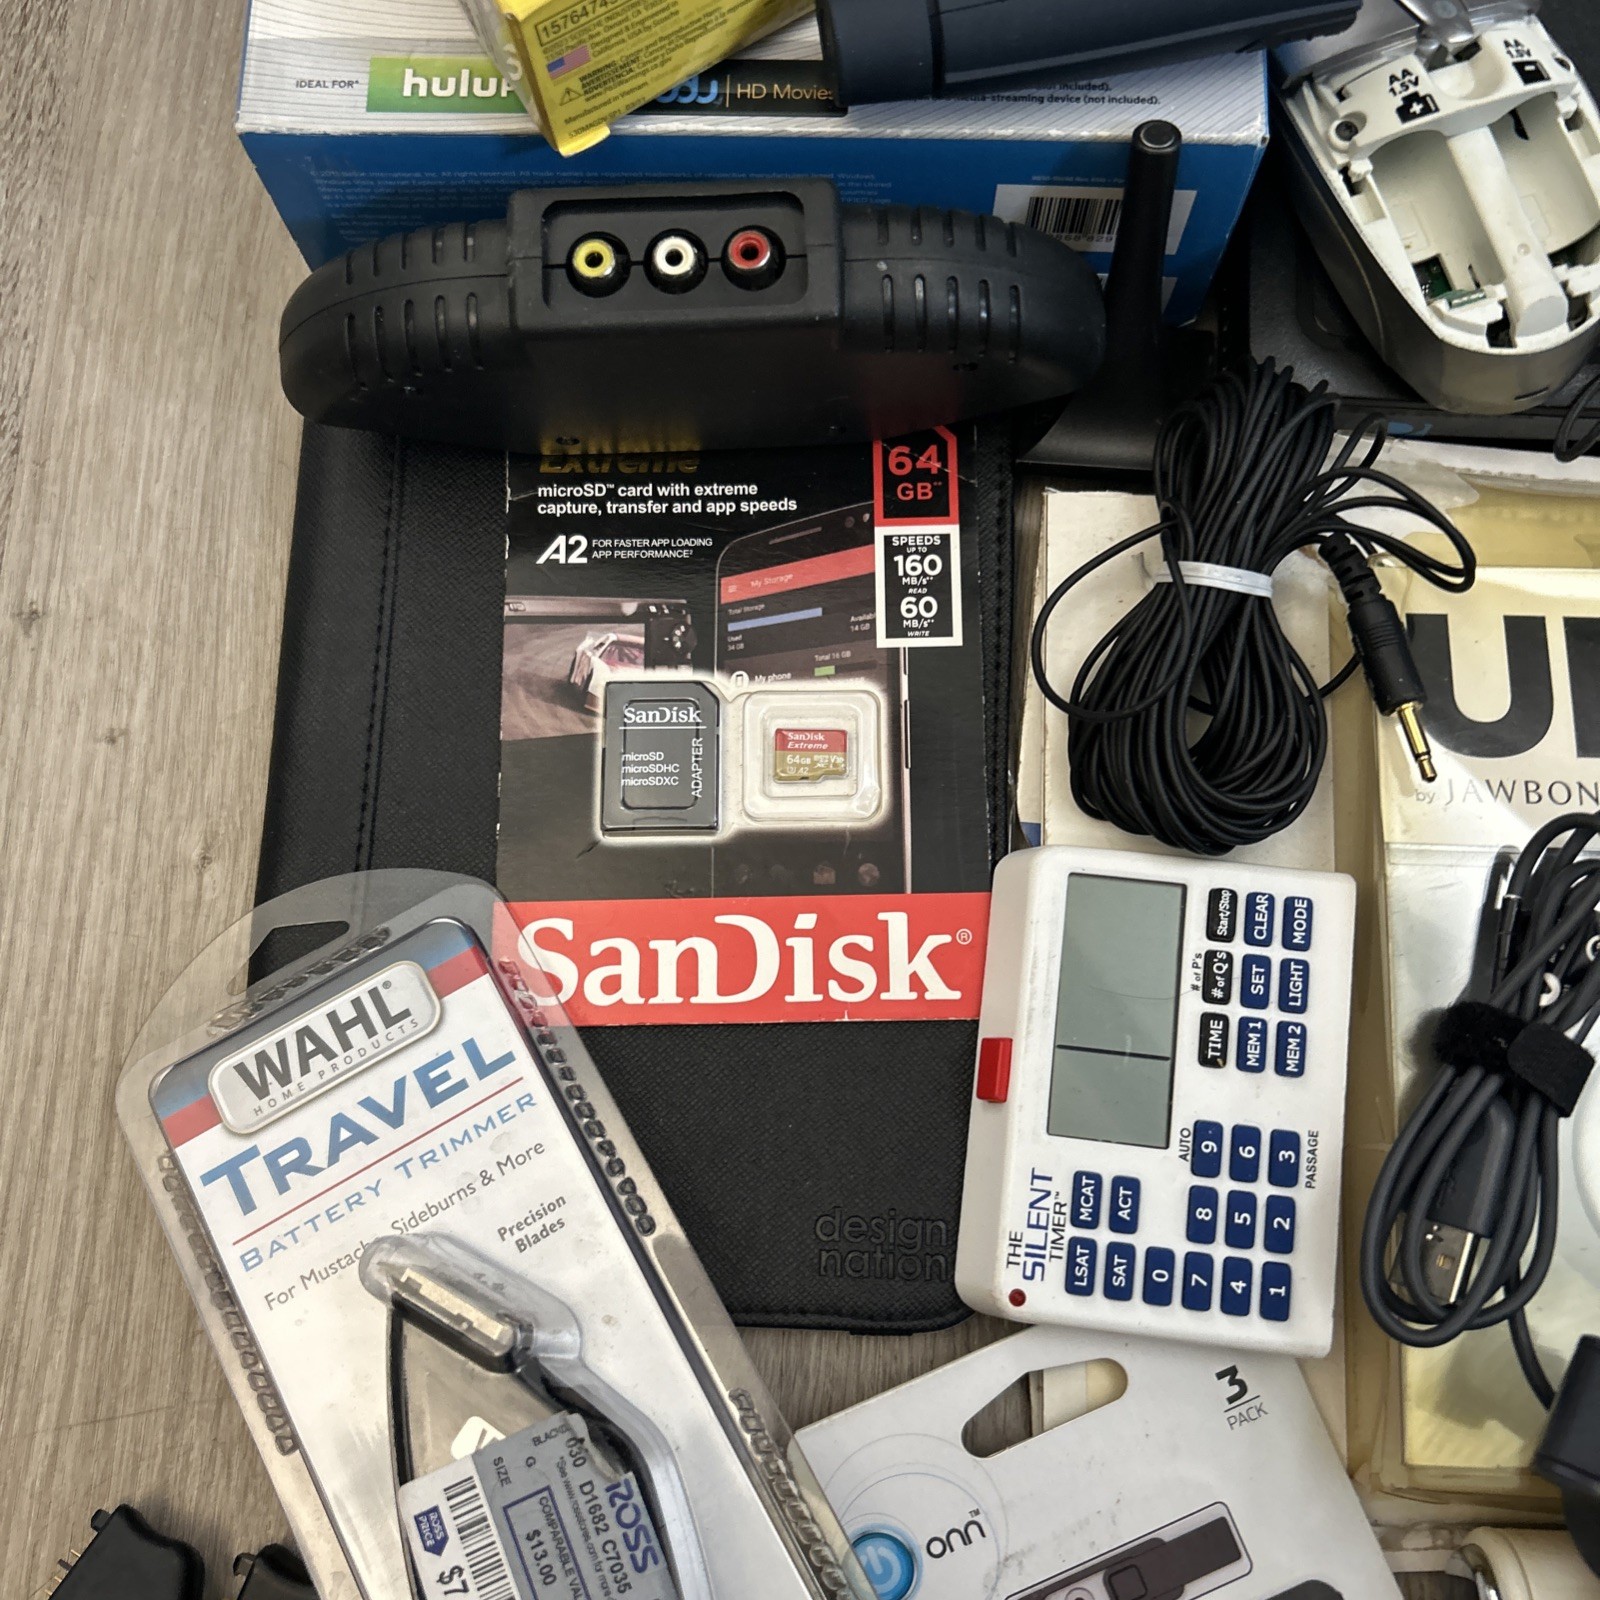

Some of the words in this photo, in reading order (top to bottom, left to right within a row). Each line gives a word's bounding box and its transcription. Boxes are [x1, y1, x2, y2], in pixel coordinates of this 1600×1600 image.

[296, 80, 329, 89] IDEAL
[737, 84, 766, 100] HD
[1387, 75, 1421, 97] 1.5V
[1047, 94, 1081, 105] device
[1083, 94, 1106, 106] (not
[1108, 94, 1161, 106] included).
[888, 444, 942, 475] 64
[617, 483, 653, 497] card
[657, 483, 690, 497] with
[694, 484, 758, 496] extreme
[537, 501, 602, 517] capture,
[606, 500, 668, 514] transfer
[672, 500, 702, 513] and
[706, 501, 736, 516] app
[739, 498, 797, 515] speeds
[535, 534, 588, 565] A2
[592, 539, 612, 548] FOR
[614, 538, 650, 548] FASTER
[651, 538, 670, 547] APP
[671, 538, 713, 547] LOADING
[892, 535, 941, 546] SPEEDS
[592, 550, 611, 558] APP
[893, 554, 943, 577] 160
[750, 579, 762, 589] My
[764, 573, 794, 586] Storage
[900, 596, 938, 618] 60
[755, 674, 768, 685] My
[769, 672, 792, 684] phone
[1405, 613, 1600, 758] U
[623, 707, 702, 724] SanDisk
[787, 741, 829, 750] Extreme
[788, 732, 825, 741] SanDisk
[621, 752, 664, 762] microSD
[691, 737, 703, 798] ADAPTER
[621, 764, 680, 774] microSDHC
[621, 776, 680, 786] microSDXC
[1415, 789, 1436, 804] by
[1217, 890, 1232, 936] Start/Stop
[1254, 894, 1269, 940] CLEAR
[1292, 899, 1308, 944] MODE
[1192, 953, 1202, 969] P's
[1213, 951, 1227, 973] Q's
[1194, 970, 1201, 981] of
[1216, 976, 1225, 987] of
[1251, 964, 1265, 995] SET
[1288, 962, 1304, 1007] LIGHT
[1211, 988, 1224, 999] #
[1249, 1021, 1262, 1029] 1
[1288, 1025, 1301, 1034] 2
[1208, 1019, 1223, 1059] TIME
[1246, 1033, 1260, 1066] MEM
[1286, 1037, 1300, 1072] MEM
[253, 1081, 306, 1116] HOME
[318, 1017, 419, 1080] PRODUCTS
[200, 1037, 516, 1216] TRAVEL
[1179, 1128, 1191, 1162] AUTO
[1200, 1140, 1217, 1153] 9
[1239, 1145, 1256, 1158] 6
[1278, 1150, 1295, 1163] 3
[1305, 1129, 1319, 1189] PASSAGE
[240, 1179, 383, 1273] BATTERY
[393, 1093, 538, 1180] TRIMMER
[1079, 1176, 1095, 1221] MCAT
[1118, 1186, 1133, 1221] ACT
[497, 1196, 566, 1241] Precision
[1022, 1167, 1053, 1282] SILENT
[1196, 1207, 1213, 1220] 8
[1234, 1212, 1251, 1225] 5
[1273, 1216, 1290, 1229] 2
[264, 1285, 297, 1311] For
[391, 1184, 476, 1235] Sideburns
[479, 1170, 496, 1186] &
[495, 1141, 546, 1175] More
[515, 1218, 565, 1252] Blades
[814, 1205, 947, 1253] design
[1006, 1231, 1023, 1269] THE
[818, 1243, 948, 1281] nation
[1074, 1245, 1090, 1286] LSAT
[1112, 1254, 1128, 1287] SAT
[1152, 1269, 1169, 1282] 0
[1191, 1273, 1208, 1287] 7
[1230, 1280, 1247, 1294] 4
[1269, 1285, 1286, 1298] 1
[1214, 1365, 1249, 1405] 3
[1226, 1402, 1269, 1431] PACK
[493, 1456, 511, 1487] SIZE
[523, 1455, 537, 1468] G
[563, 1435, 588, 1469] 030
[579, 1480, 609, 1536] D1682
[602, 1539, 632, 1594] C7035
[417, 1515, 435, 1547] PRICE
[539, 1497, 574, 1577] COMPARABLE
[605, 1479, 659, 1574] ROSS
[526, 1529, 556, 1586] $13.00
